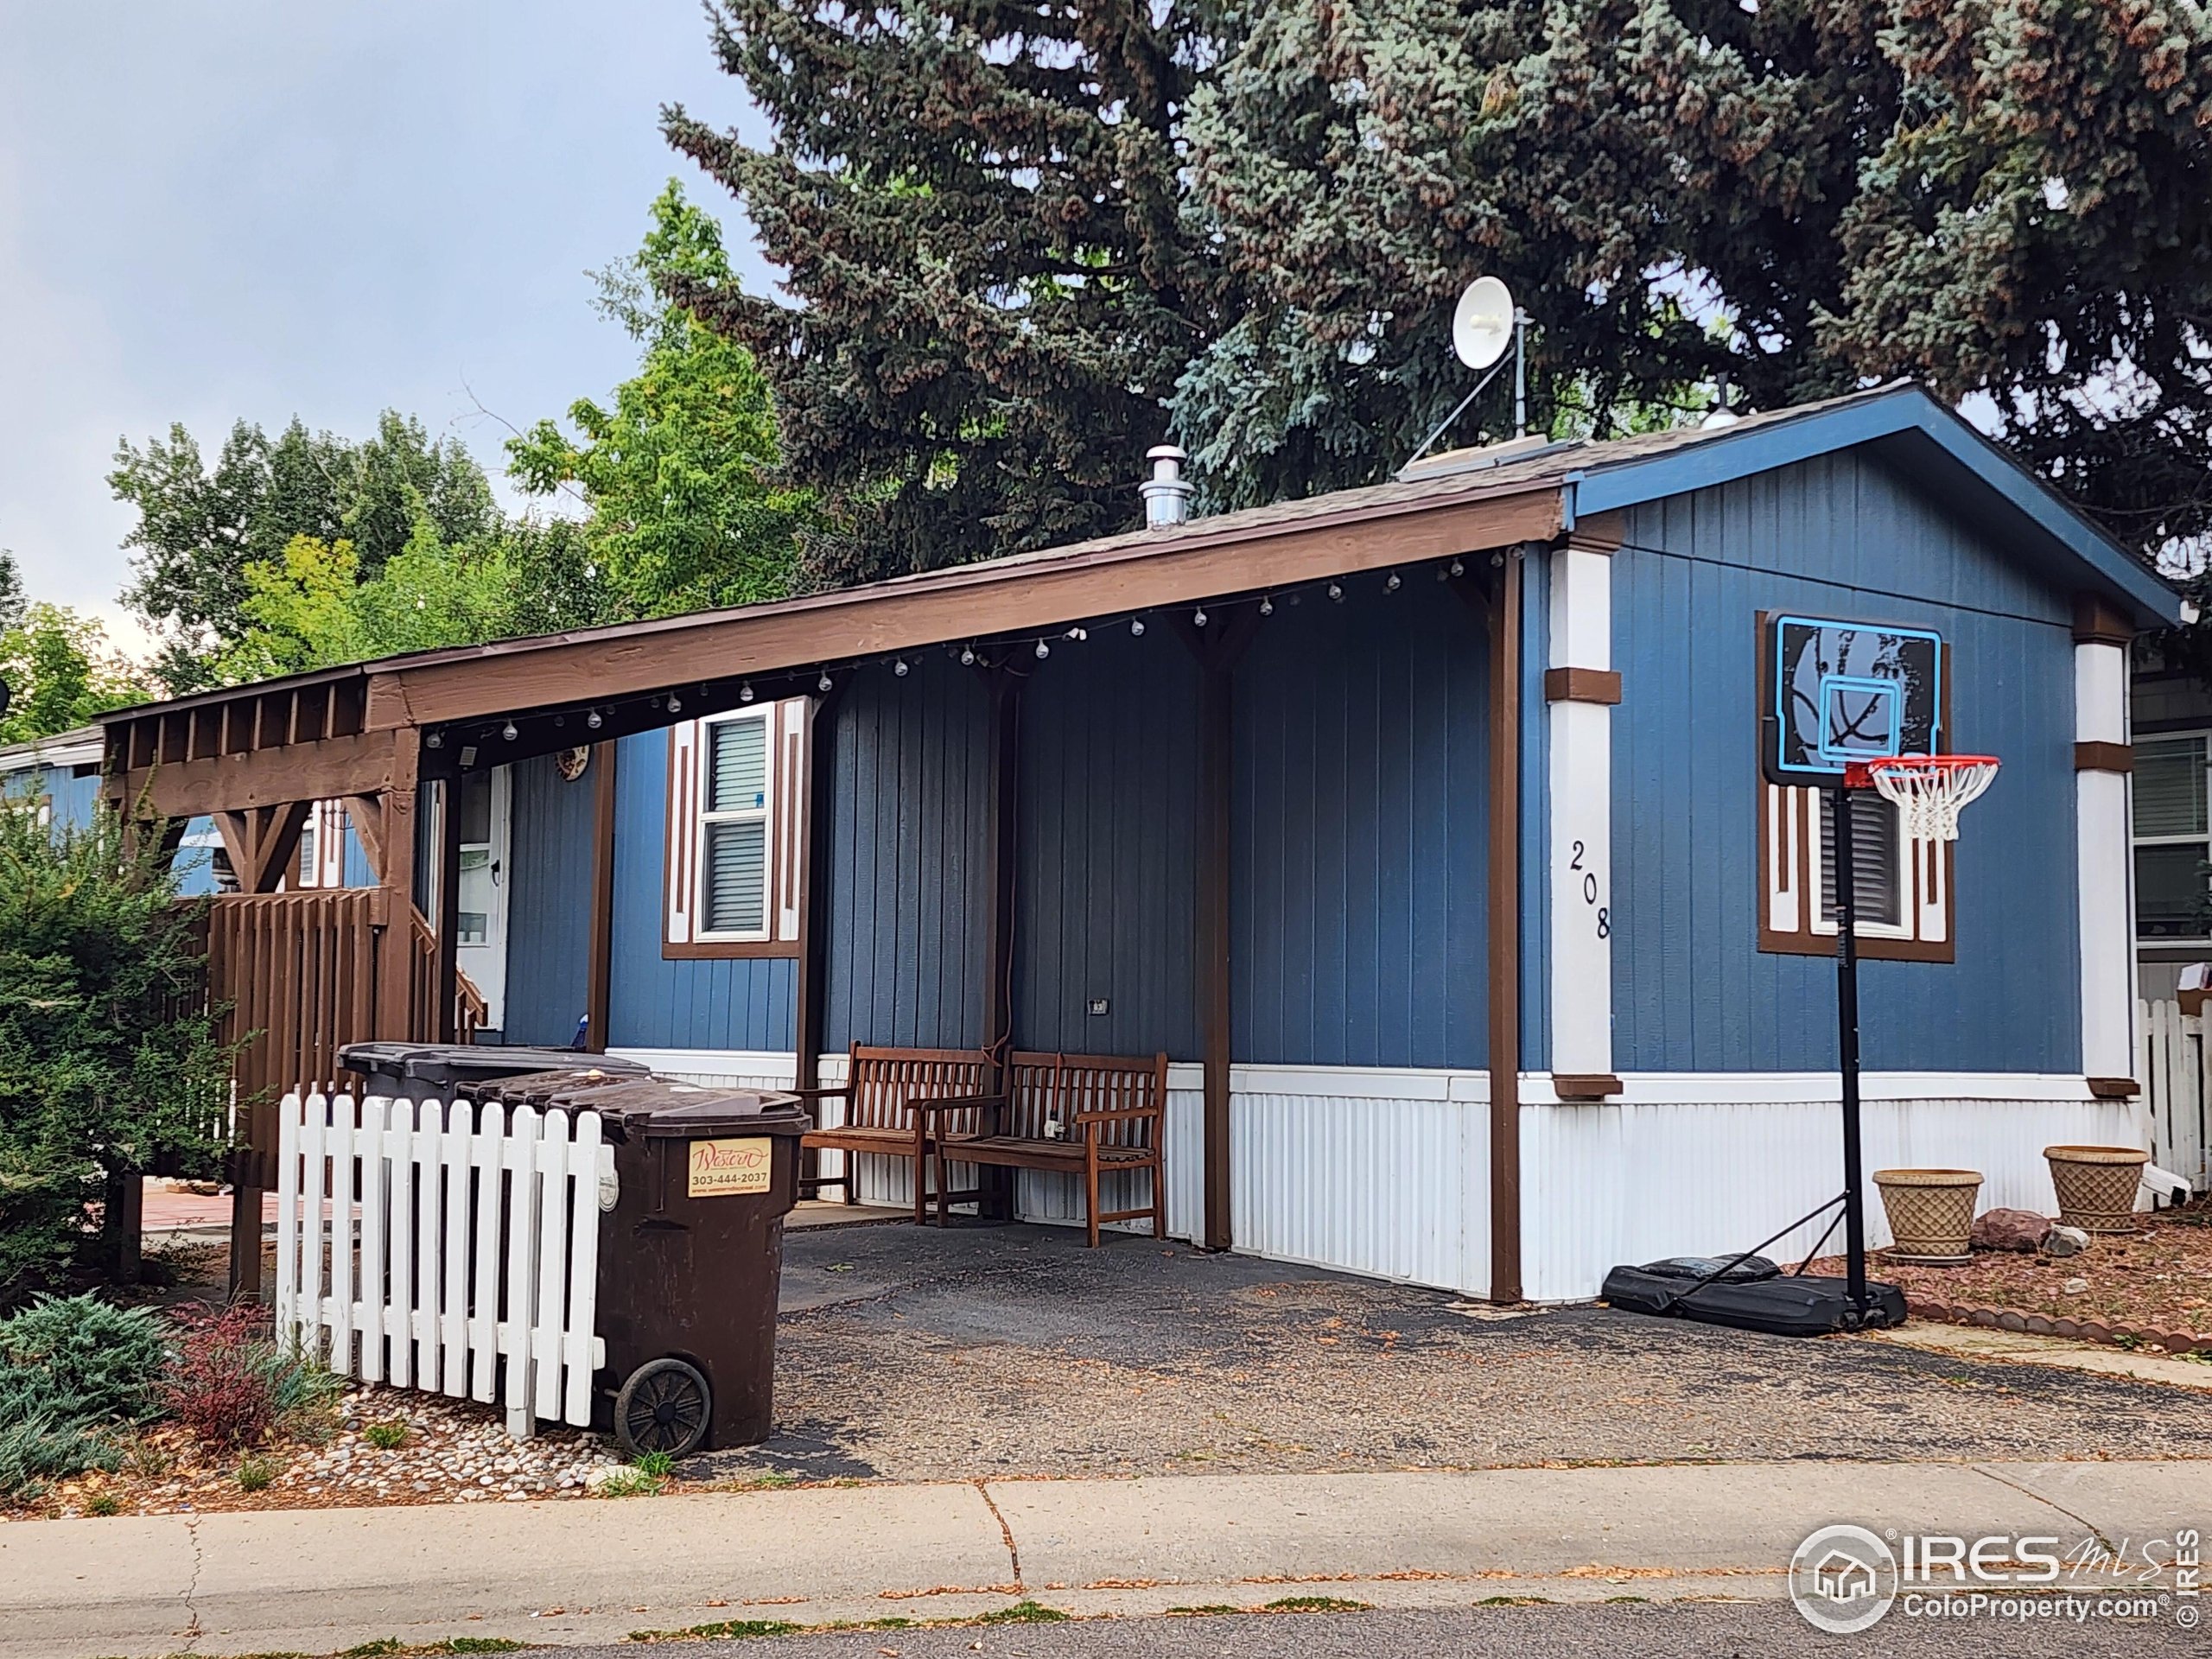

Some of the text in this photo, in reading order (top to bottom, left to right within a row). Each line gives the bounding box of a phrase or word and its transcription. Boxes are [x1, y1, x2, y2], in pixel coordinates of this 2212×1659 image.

[1570, 840, 1611, 940] 208
[692, 1142, 769, 1172] Western
[692, 1173, 767, 1185] 303-444-2037
